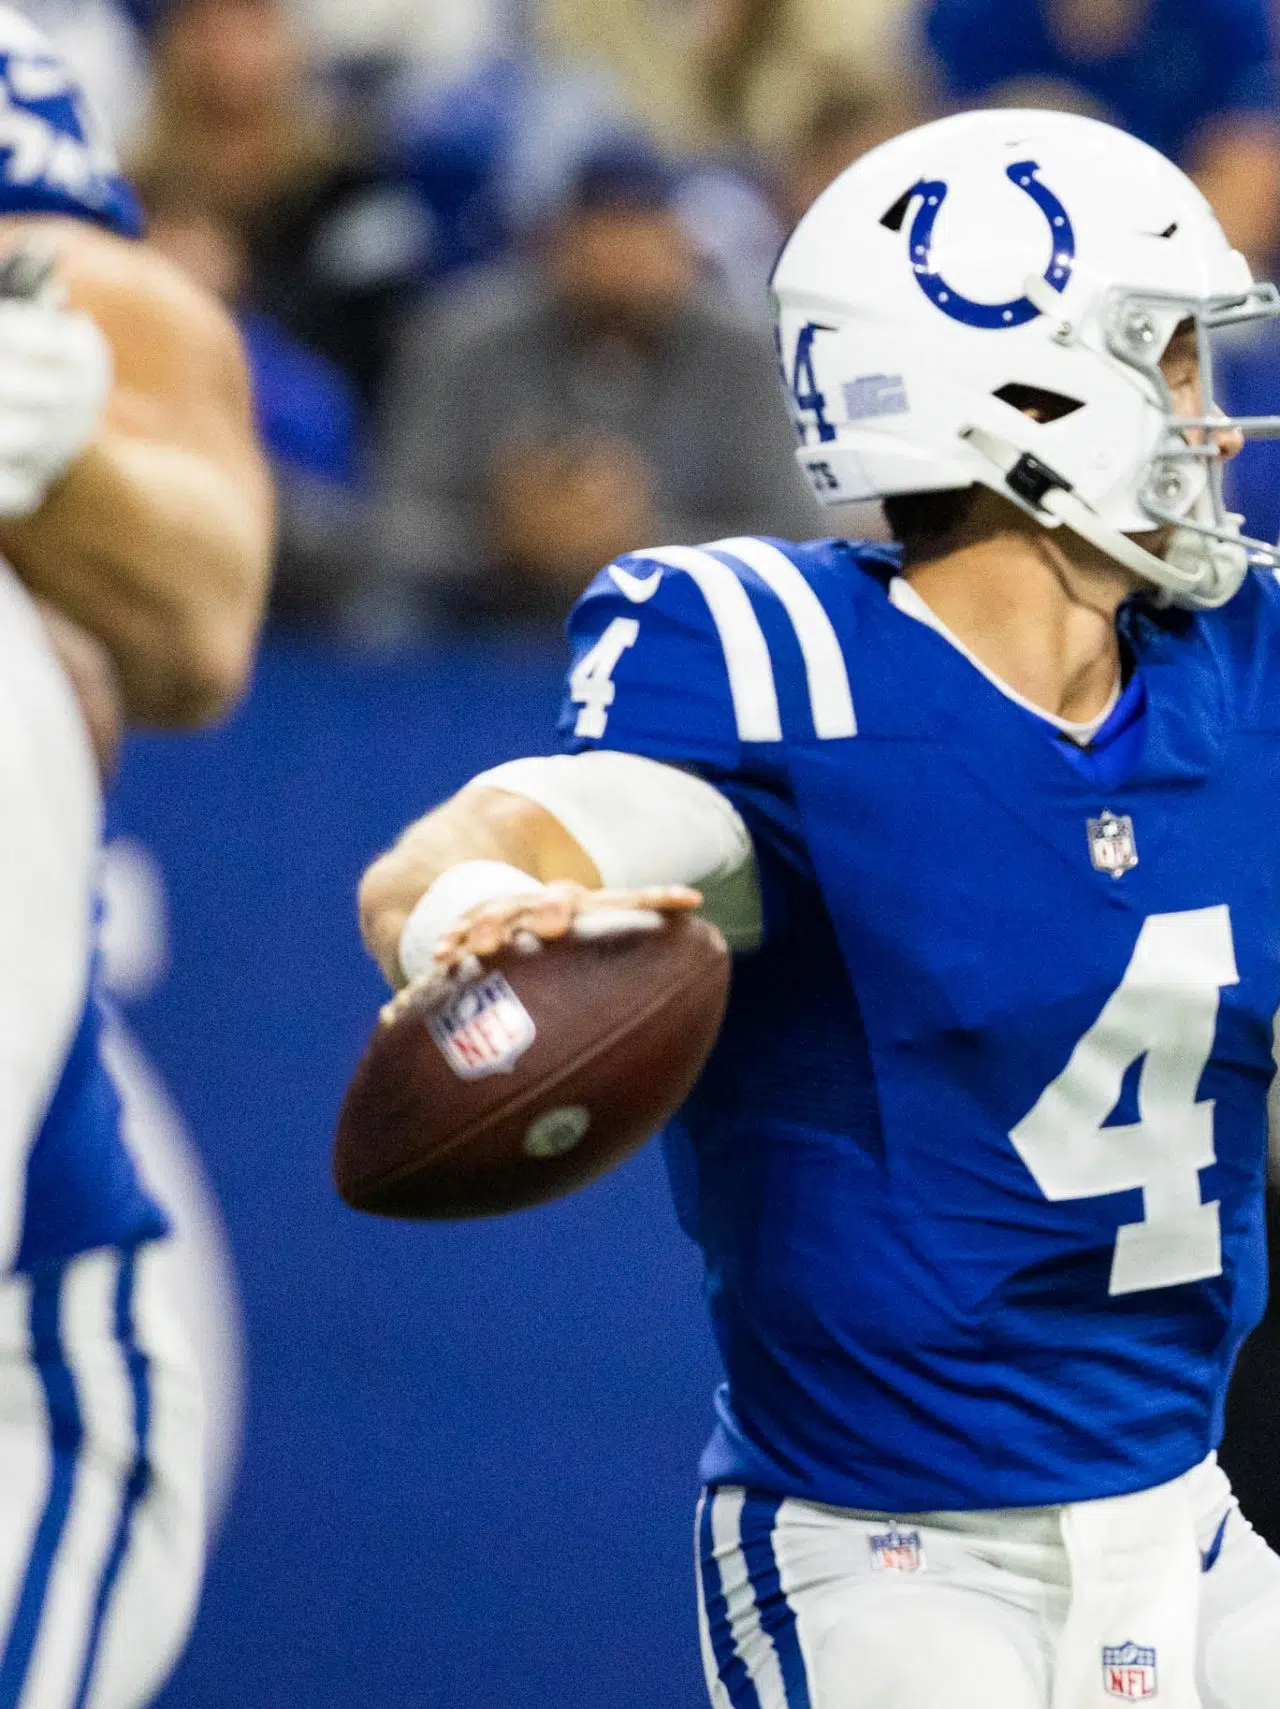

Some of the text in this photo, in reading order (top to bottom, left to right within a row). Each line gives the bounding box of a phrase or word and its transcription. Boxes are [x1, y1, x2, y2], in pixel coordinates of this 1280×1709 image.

[793, 322, 836, 441] 4
[570, 617, 640, 739] 4
[1008, 904, 1239, 1296] 4
[1108, 1667, 1153, 1696] NFL
